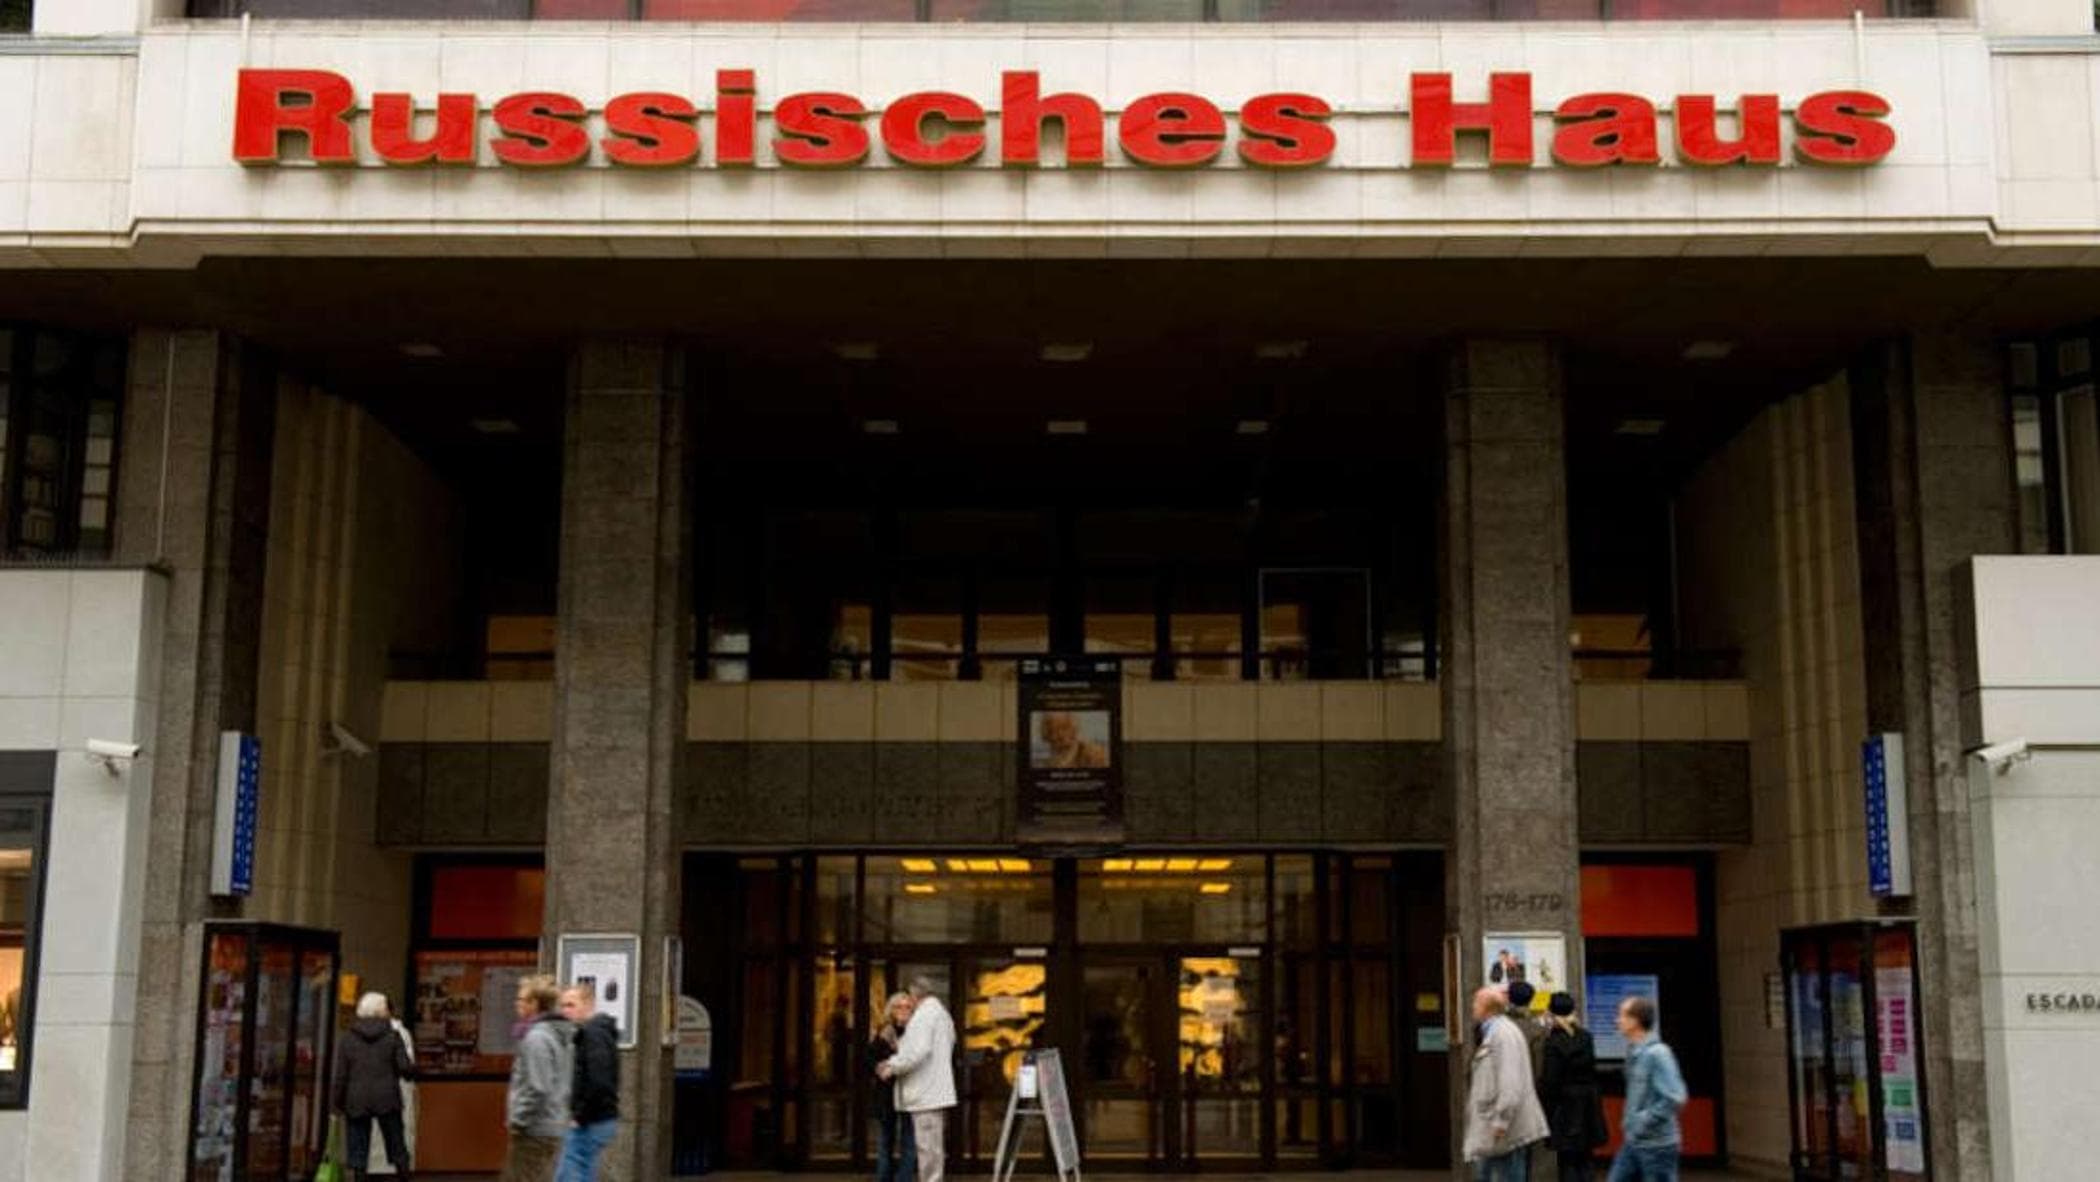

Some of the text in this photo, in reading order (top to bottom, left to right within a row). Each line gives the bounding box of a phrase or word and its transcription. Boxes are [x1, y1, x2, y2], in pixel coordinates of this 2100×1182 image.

[232, 68, 1896, 167] Russisches Haus
[2026, 993, 2100, 1011] ESCAD
